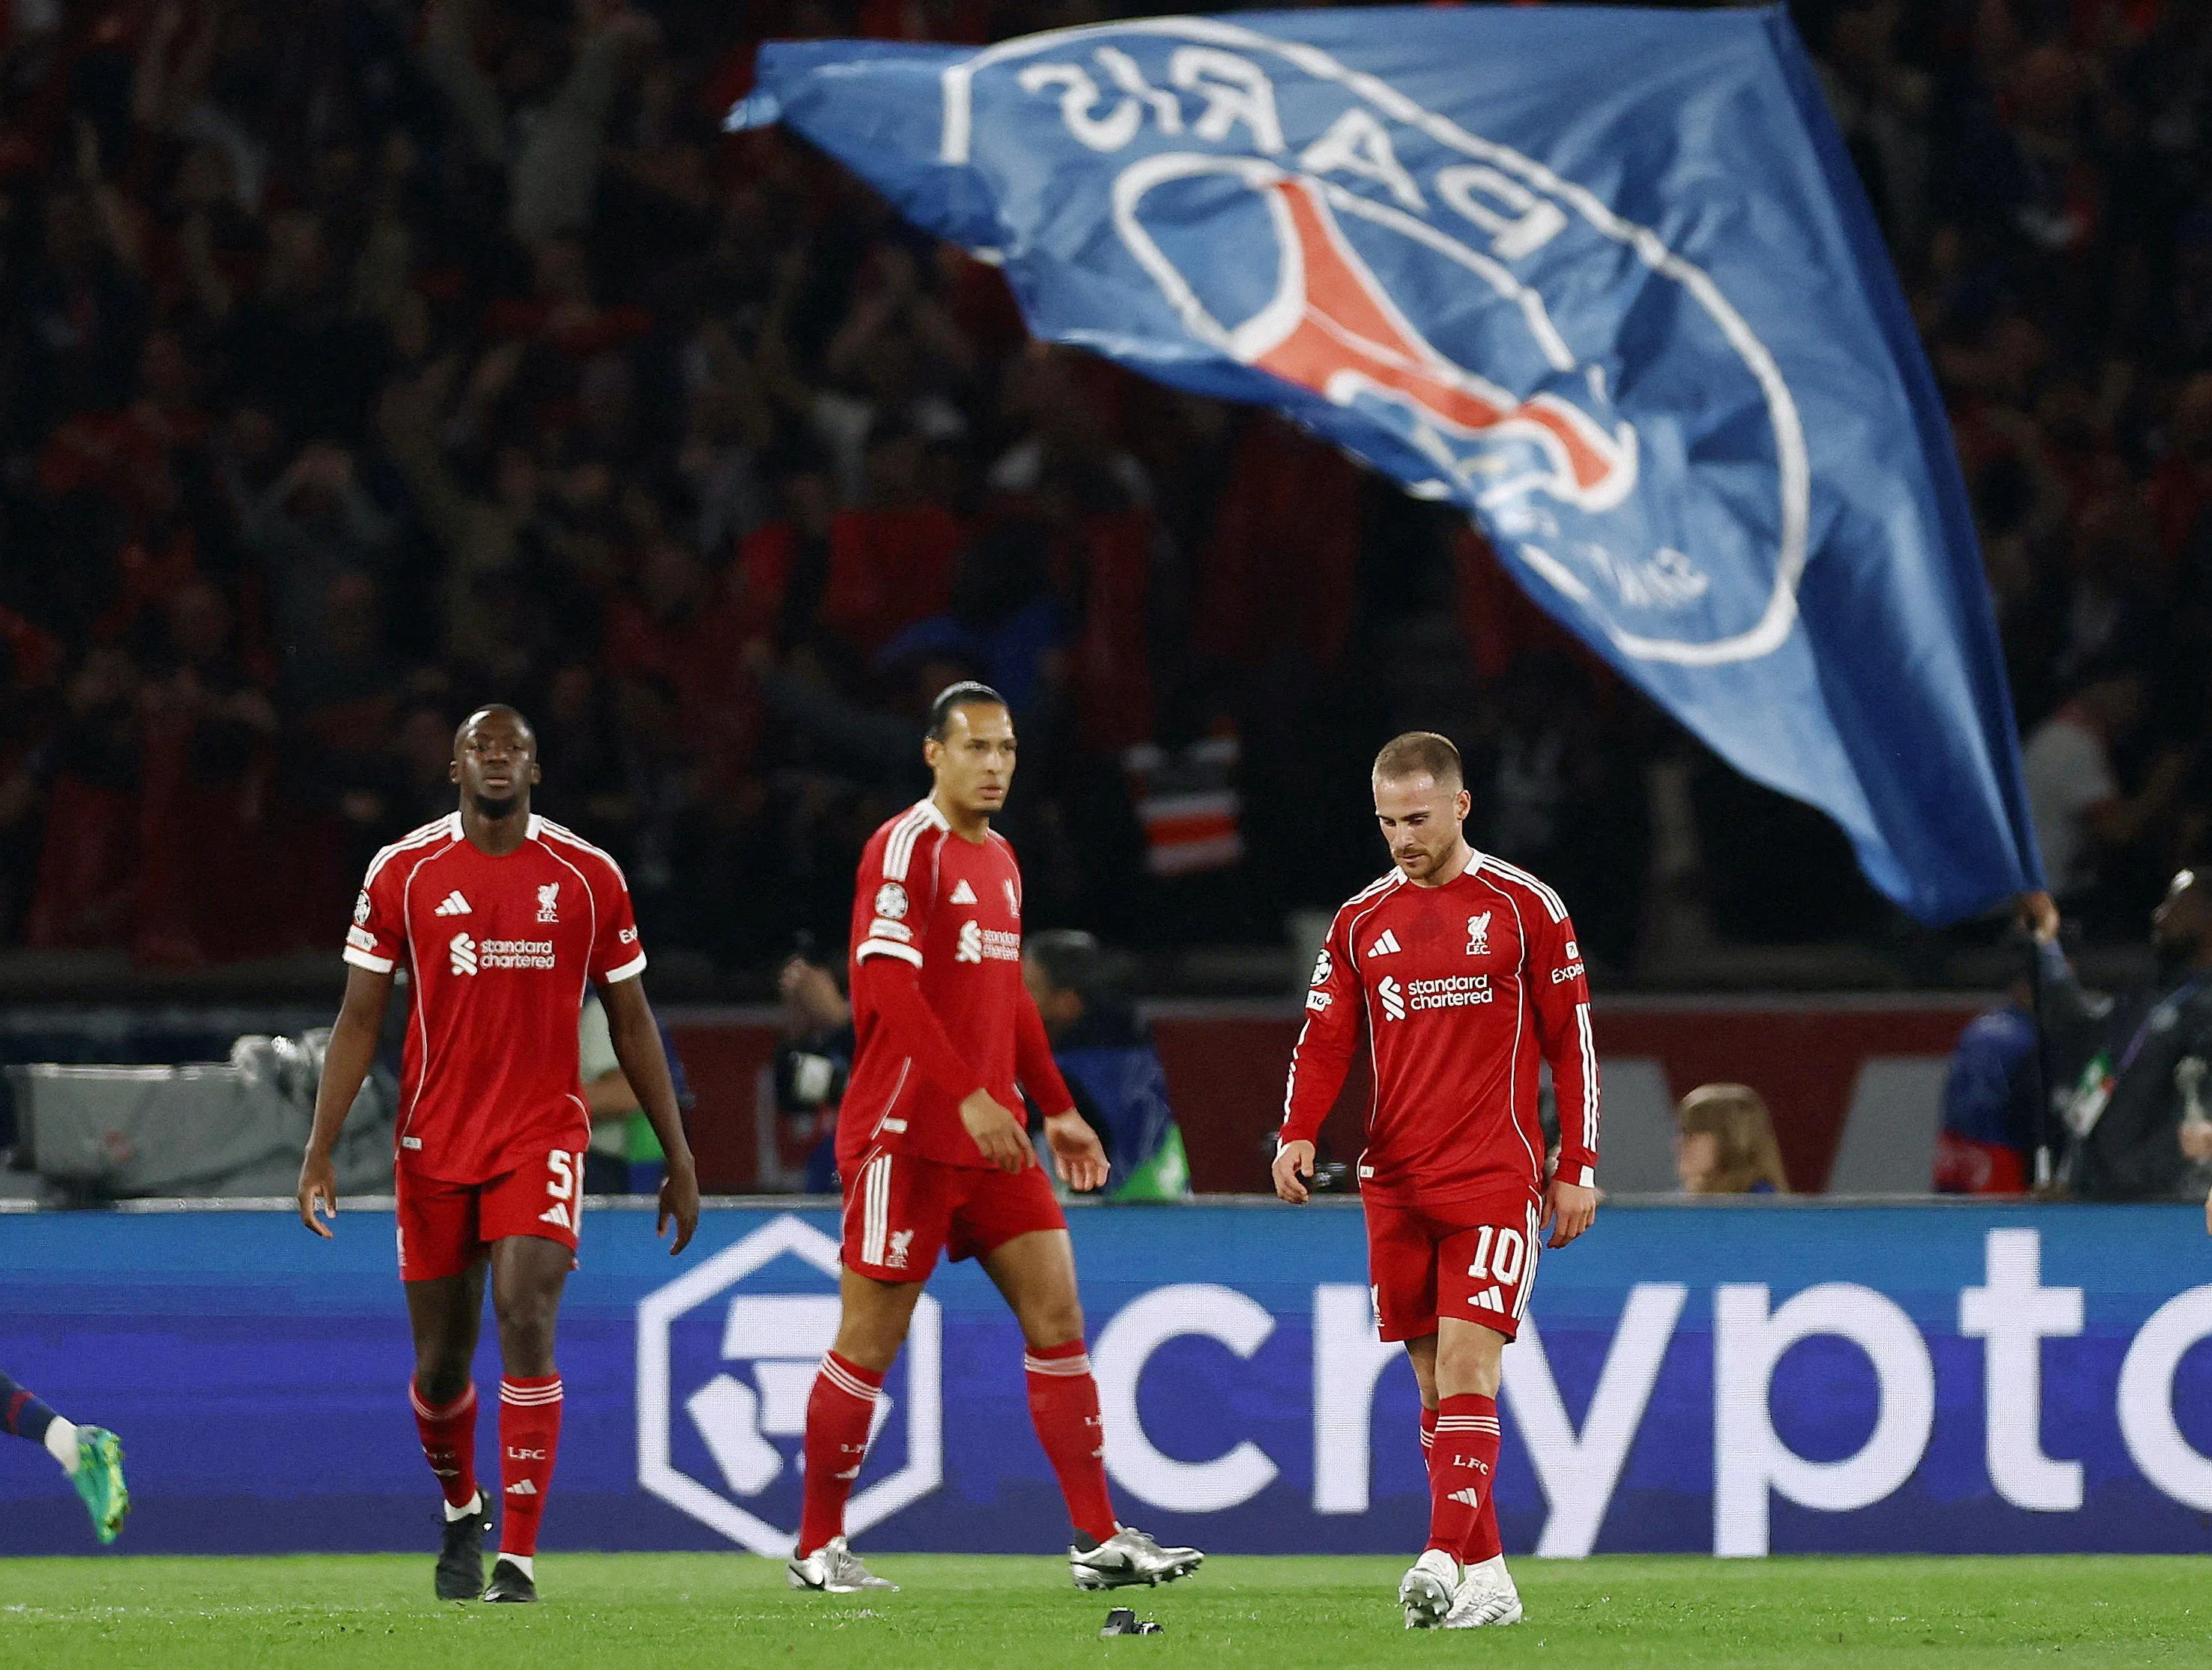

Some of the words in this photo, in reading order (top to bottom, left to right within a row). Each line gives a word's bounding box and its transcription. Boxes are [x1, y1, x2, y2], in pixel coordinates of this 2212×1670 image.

[480, 938, 553, 954] standard
[480, 953, 556, 969] chartered
[1408, 974, 1488, 995] standard
[1410, 988, 1493, 1010] chartered
[546, 1150, 574, 1200] 5
[1468, 1224, 1524, 1287] 10
[507, 1445, 545, 1460] LFC
[1453, 1454, 1489, 1475] LFC
